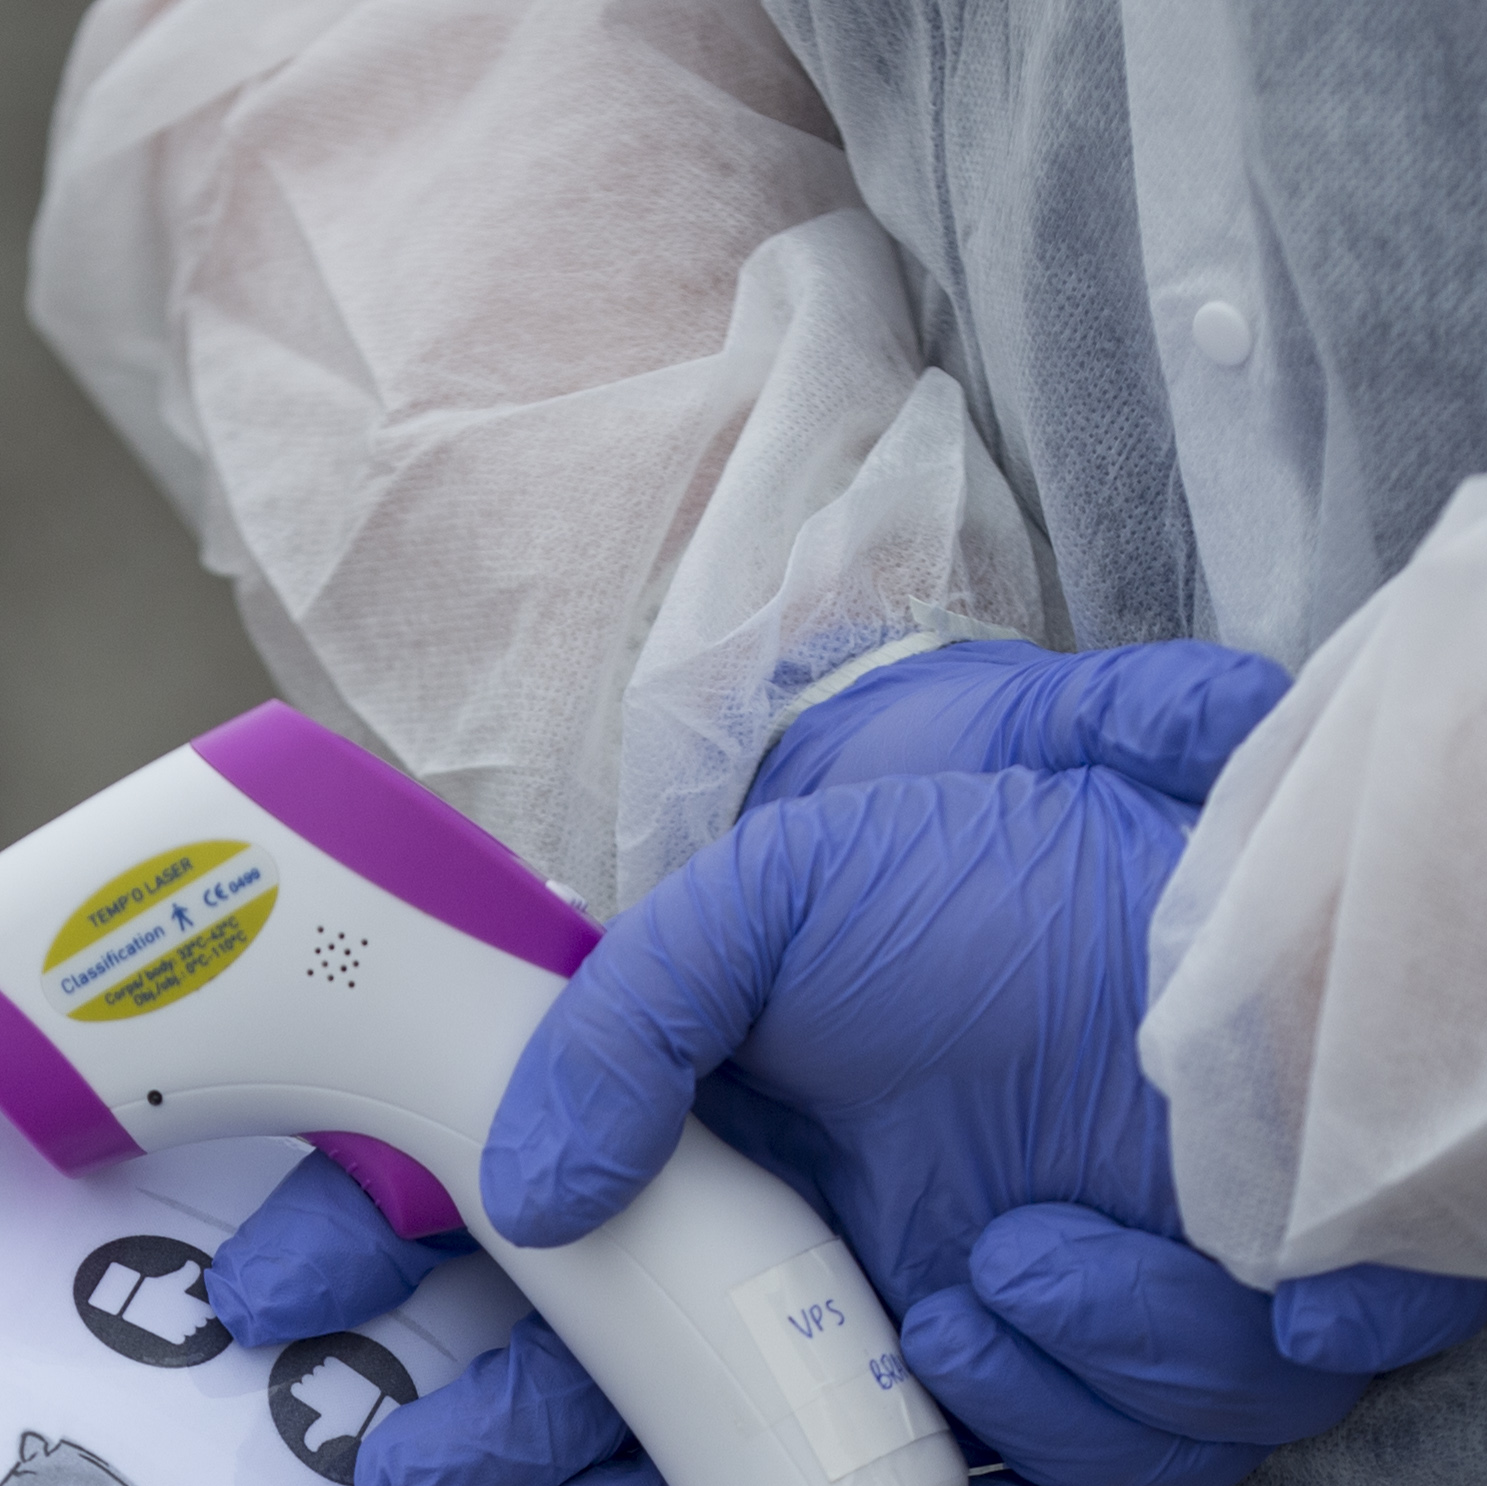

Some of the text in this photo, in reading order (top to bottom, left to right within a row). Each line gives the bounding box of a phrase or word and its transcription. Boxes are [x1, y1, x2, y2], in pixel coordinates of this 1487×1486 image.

[144, 857, 193, 895] LASER
[61, 925, 166, 995] Classification
[203, 882, 229, 908] CE
